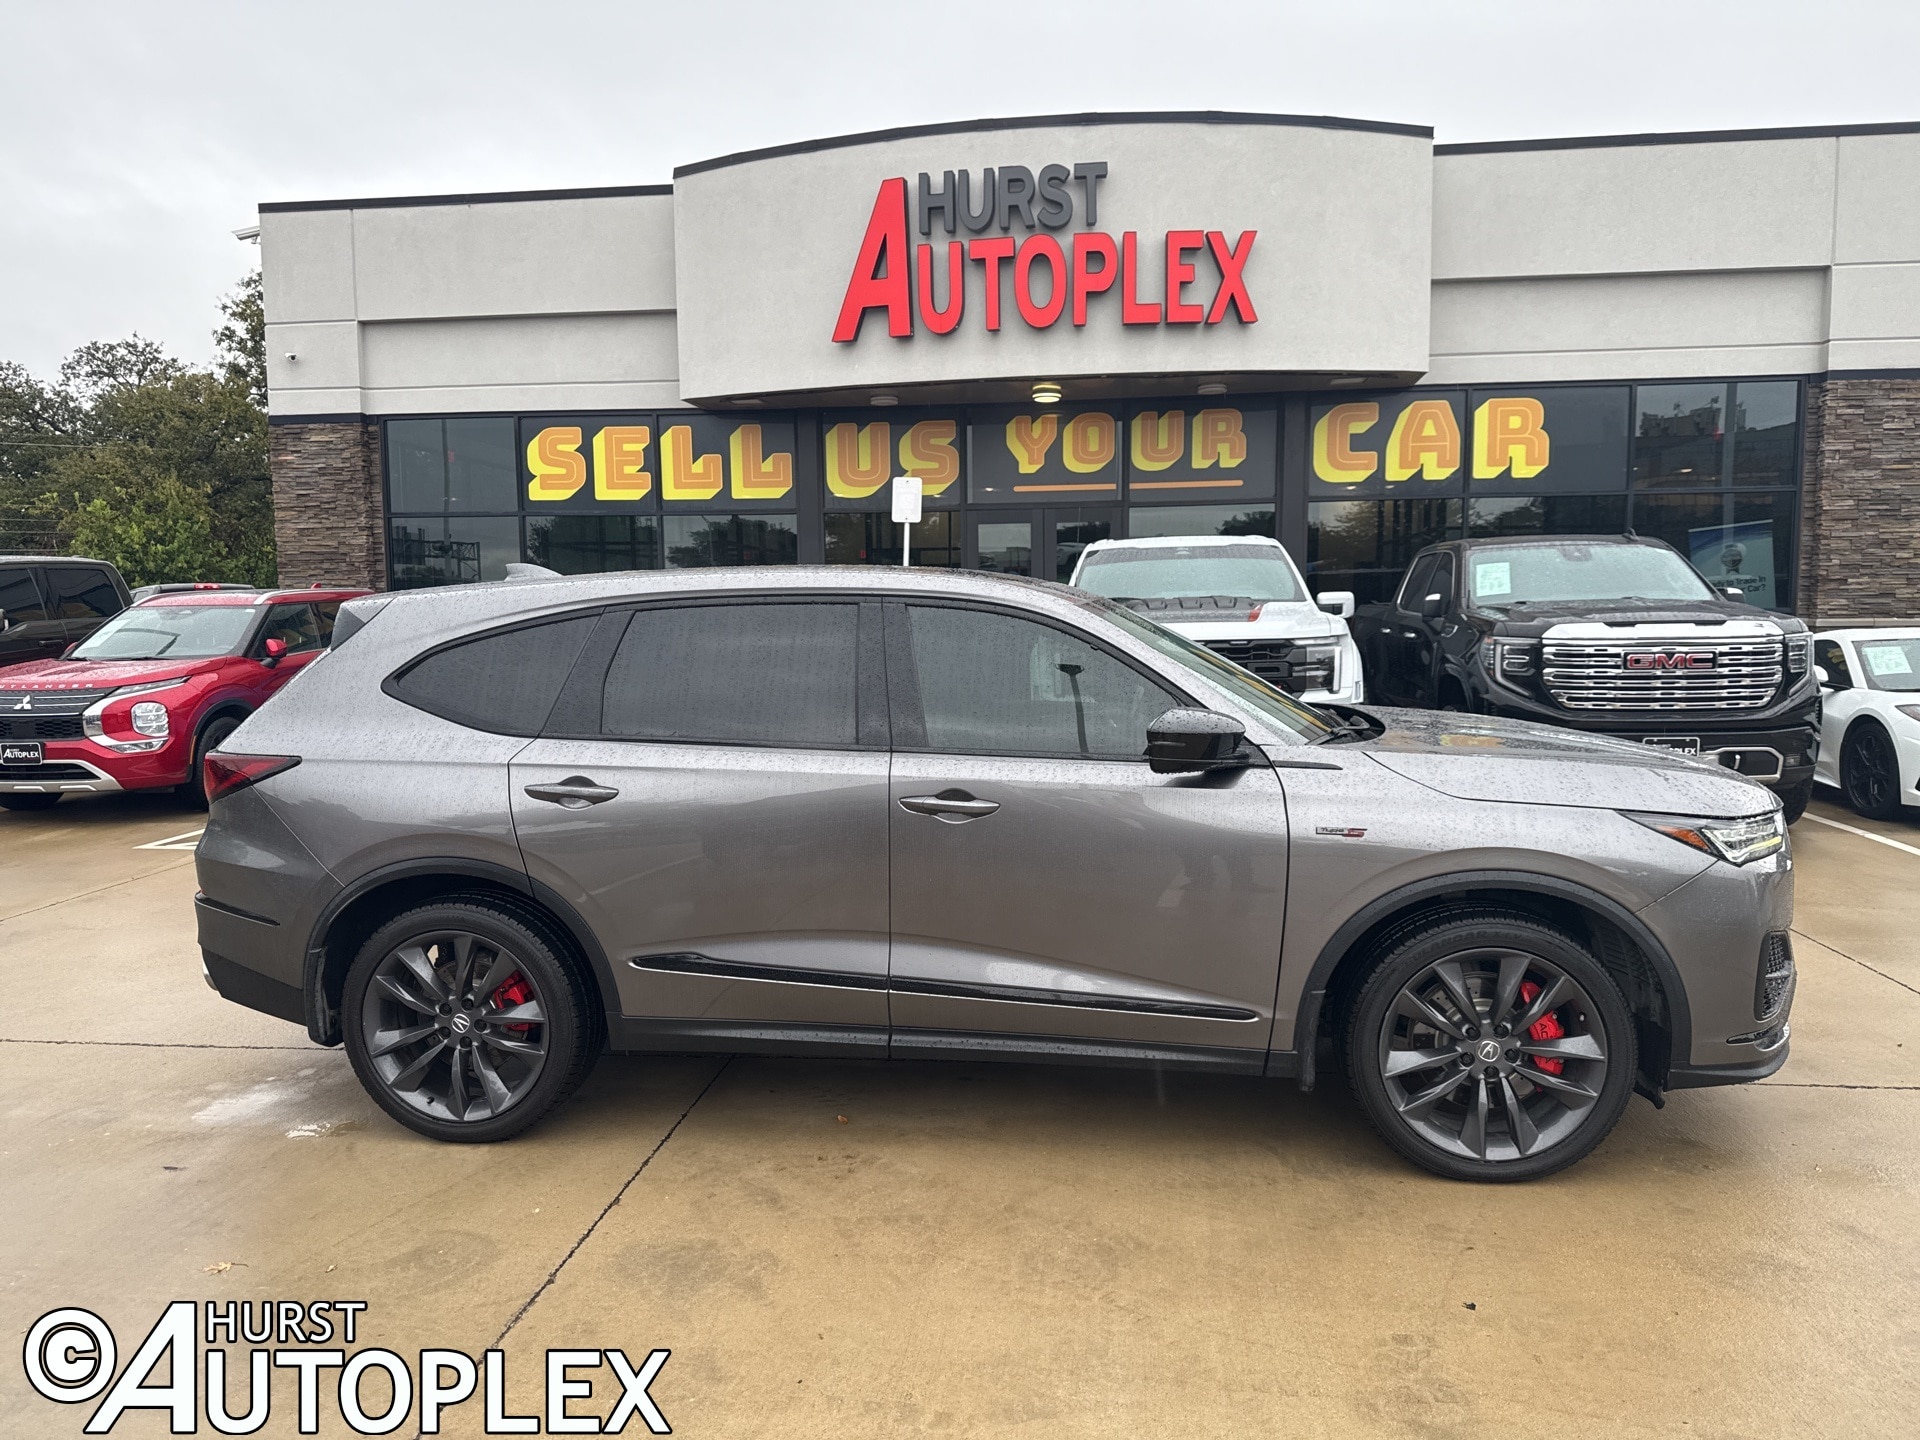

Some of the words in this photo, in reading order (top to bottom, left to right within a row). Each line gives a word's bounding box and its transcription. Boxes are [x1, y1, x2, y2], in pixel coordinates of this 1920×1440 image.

[918, 161, 1108, 235] HURST
[831, 177, 1258, 343] AUTOPLEX
[526, 424, 793, 501] SELL
[825, 419, 960, 499] US
[1006, 407, 1248, 474] YOUR
[1312, 397, 1551, 483] CAR
[1736, 577, 1757, 585] Trade
[1747, 583, 1766, 592] Car?
[1626, 653, 1714, 669] GMC
[3, 748, 40, 758] AUTOPLEX
